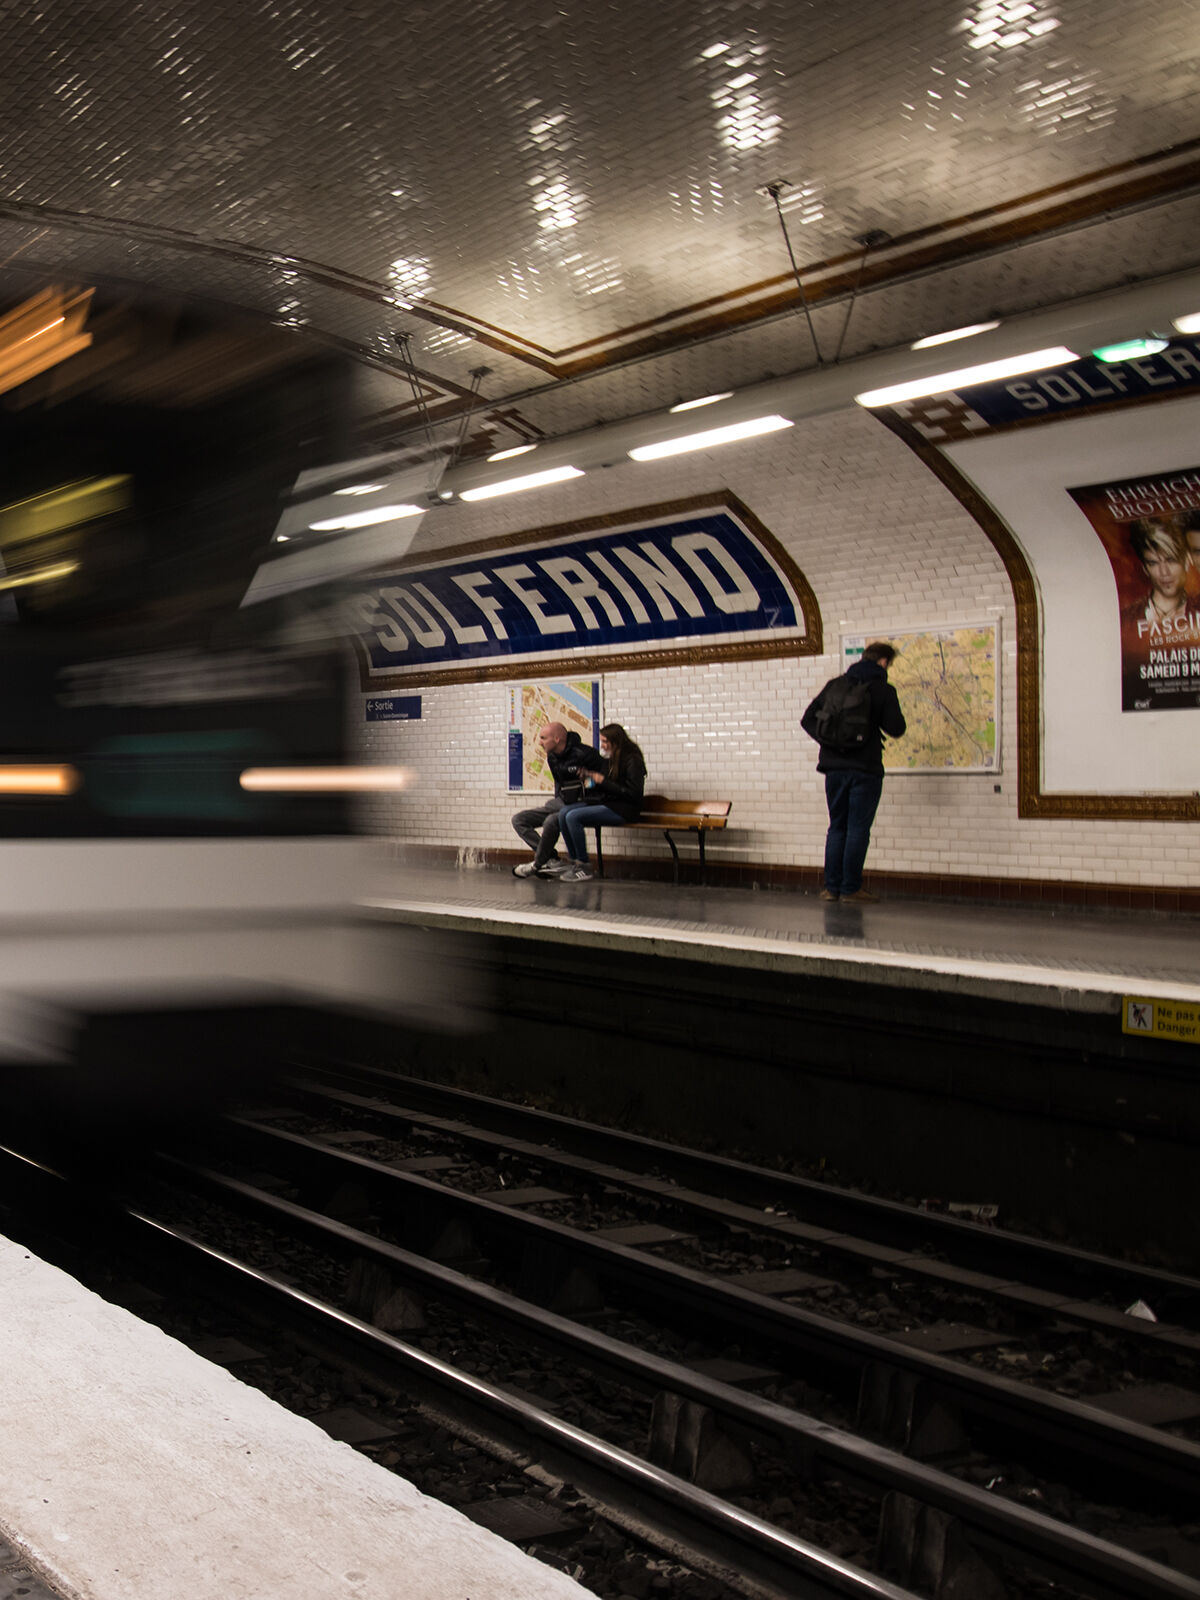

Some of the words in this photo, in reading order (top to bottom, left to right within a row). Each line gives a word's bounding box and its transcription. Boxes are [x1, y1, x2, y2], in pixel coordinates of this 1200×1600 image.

[1005, 343, 1200, 410] SOLFER
[1105, 474, 1200, 503] EHRLICH
[1108, 492, 1200, 519] BROTHE
[360, 532, 761, 652] SOLFERINO
[1150, 636, 1164, 646] LES
[1166, 633, 1190, 644] ROCK
[1150, 648, 1188, 664] PALAIS
[1140, 664, 1180, 679] SAMEDI
[374, 700, 393, 711] Sortie
[1158, 1007, 1173, 1019] Ne
[1176, 1010, 1195, 1021] pas
[1157, 1022, 1196, 1037] Danger
